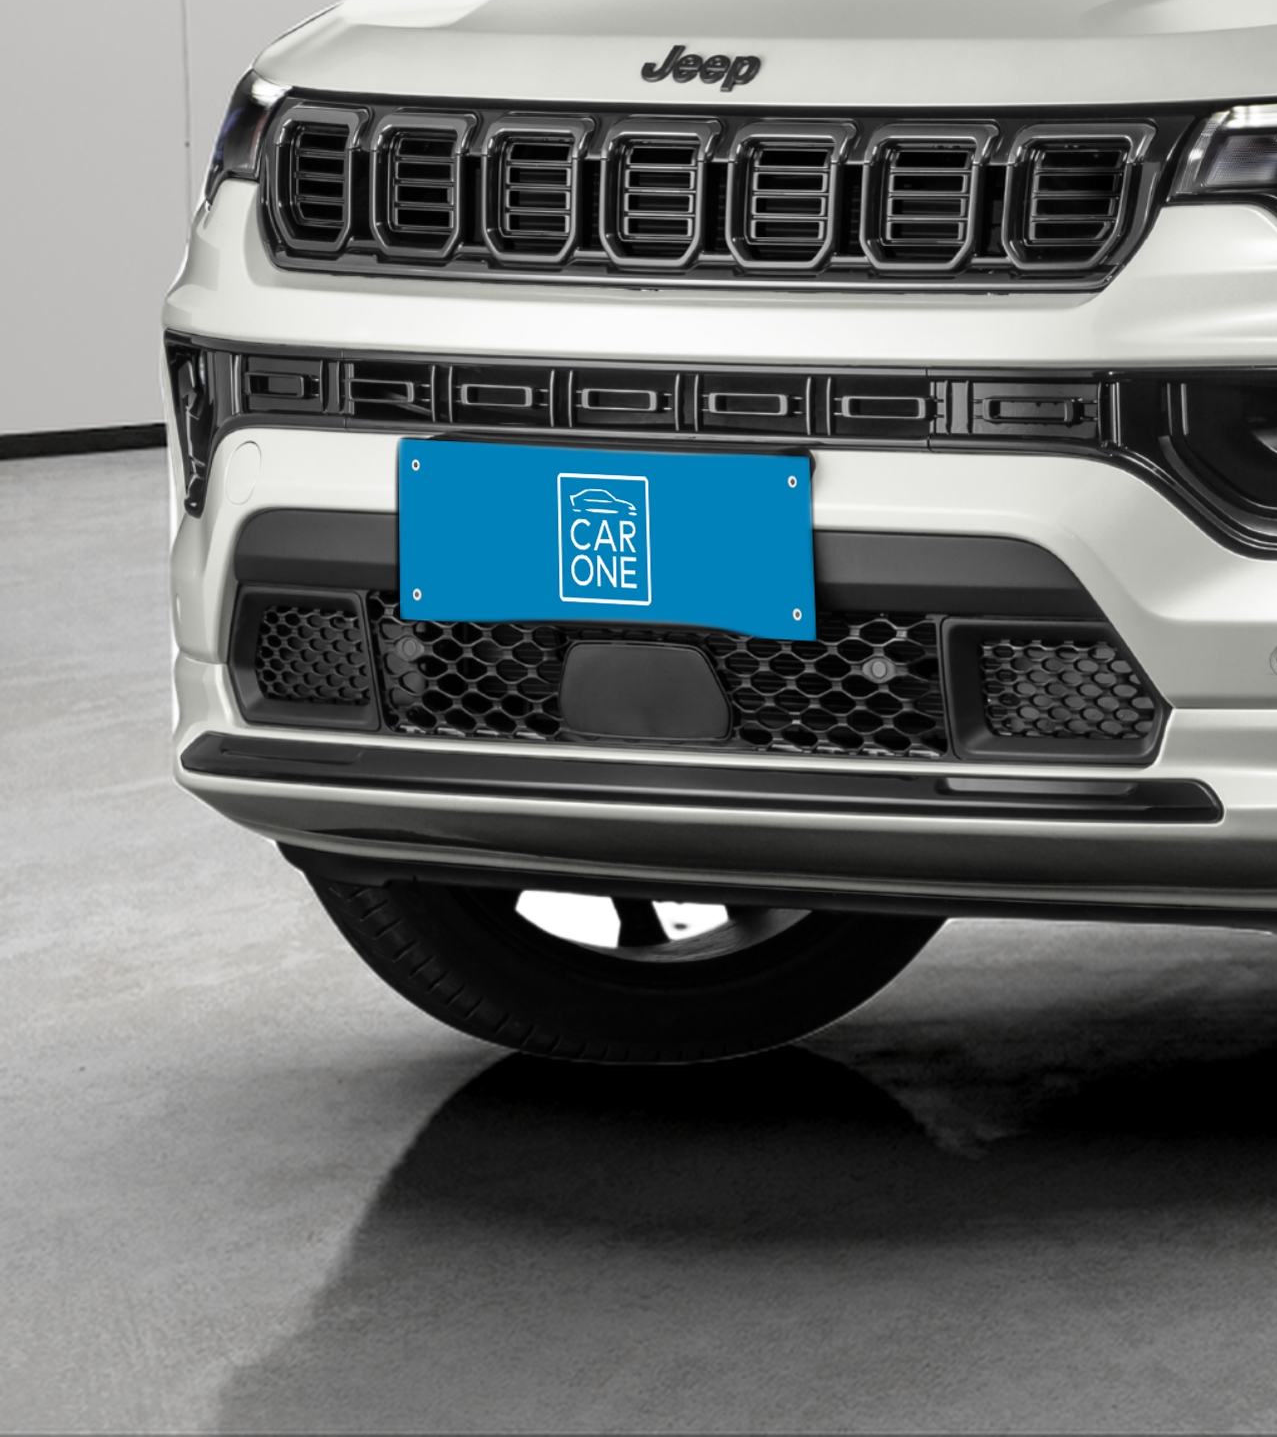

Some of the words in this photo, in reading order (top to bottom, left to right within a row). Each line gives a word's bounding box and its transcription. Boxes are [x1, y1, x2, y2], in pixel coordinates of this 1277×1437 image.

[641, 44, 761, 92] Jeep
[570, 518, 636, 553] CAR
[570, 554, 637, 589] ONE
